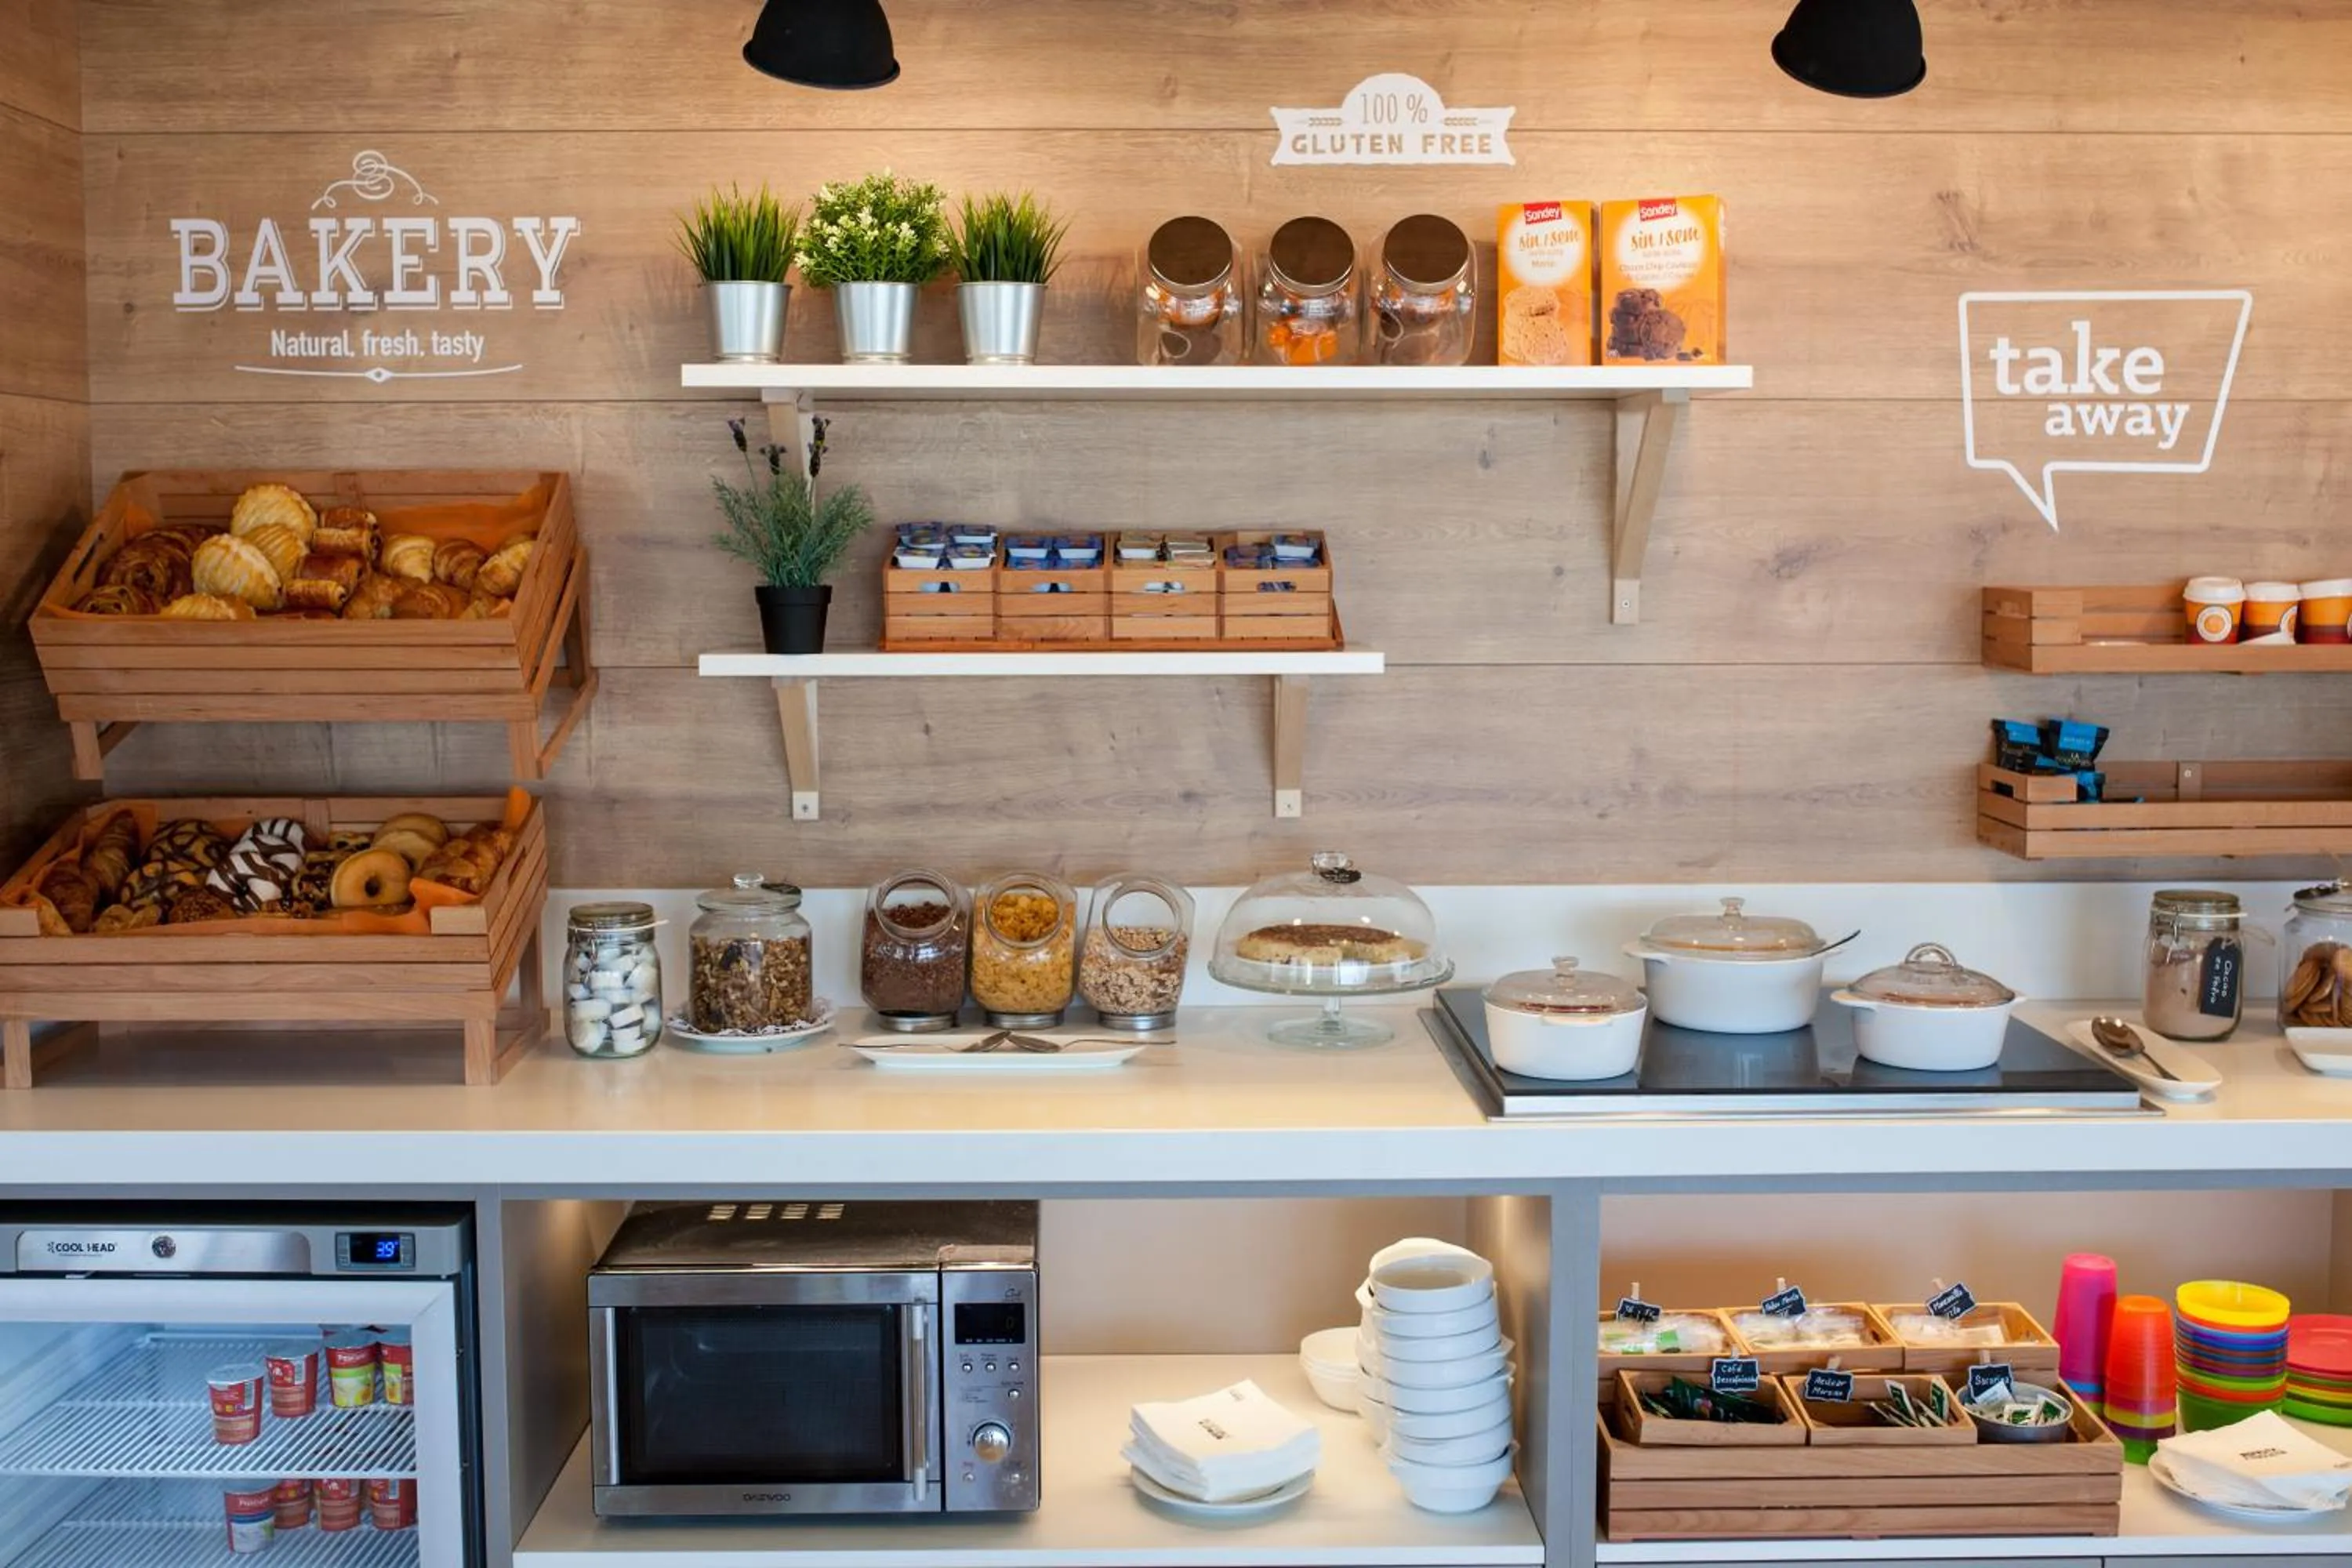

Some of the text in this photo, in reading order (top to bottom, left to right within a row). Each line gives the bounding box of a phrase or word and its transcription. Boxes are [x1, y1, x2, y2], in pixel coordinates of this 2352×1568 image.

[1360, 93, 1399, 124] 100
[1290, 133, 1492, 154] GLUTEN FREE
[170, 217, 581, 312] BAKERY
[430, 330, 485, 363] tasty
[1989, 320, 2165, 395] take
[2044, 402, 2190, 450] away
[56, 1243, 116, 1253] COOL HEAD
